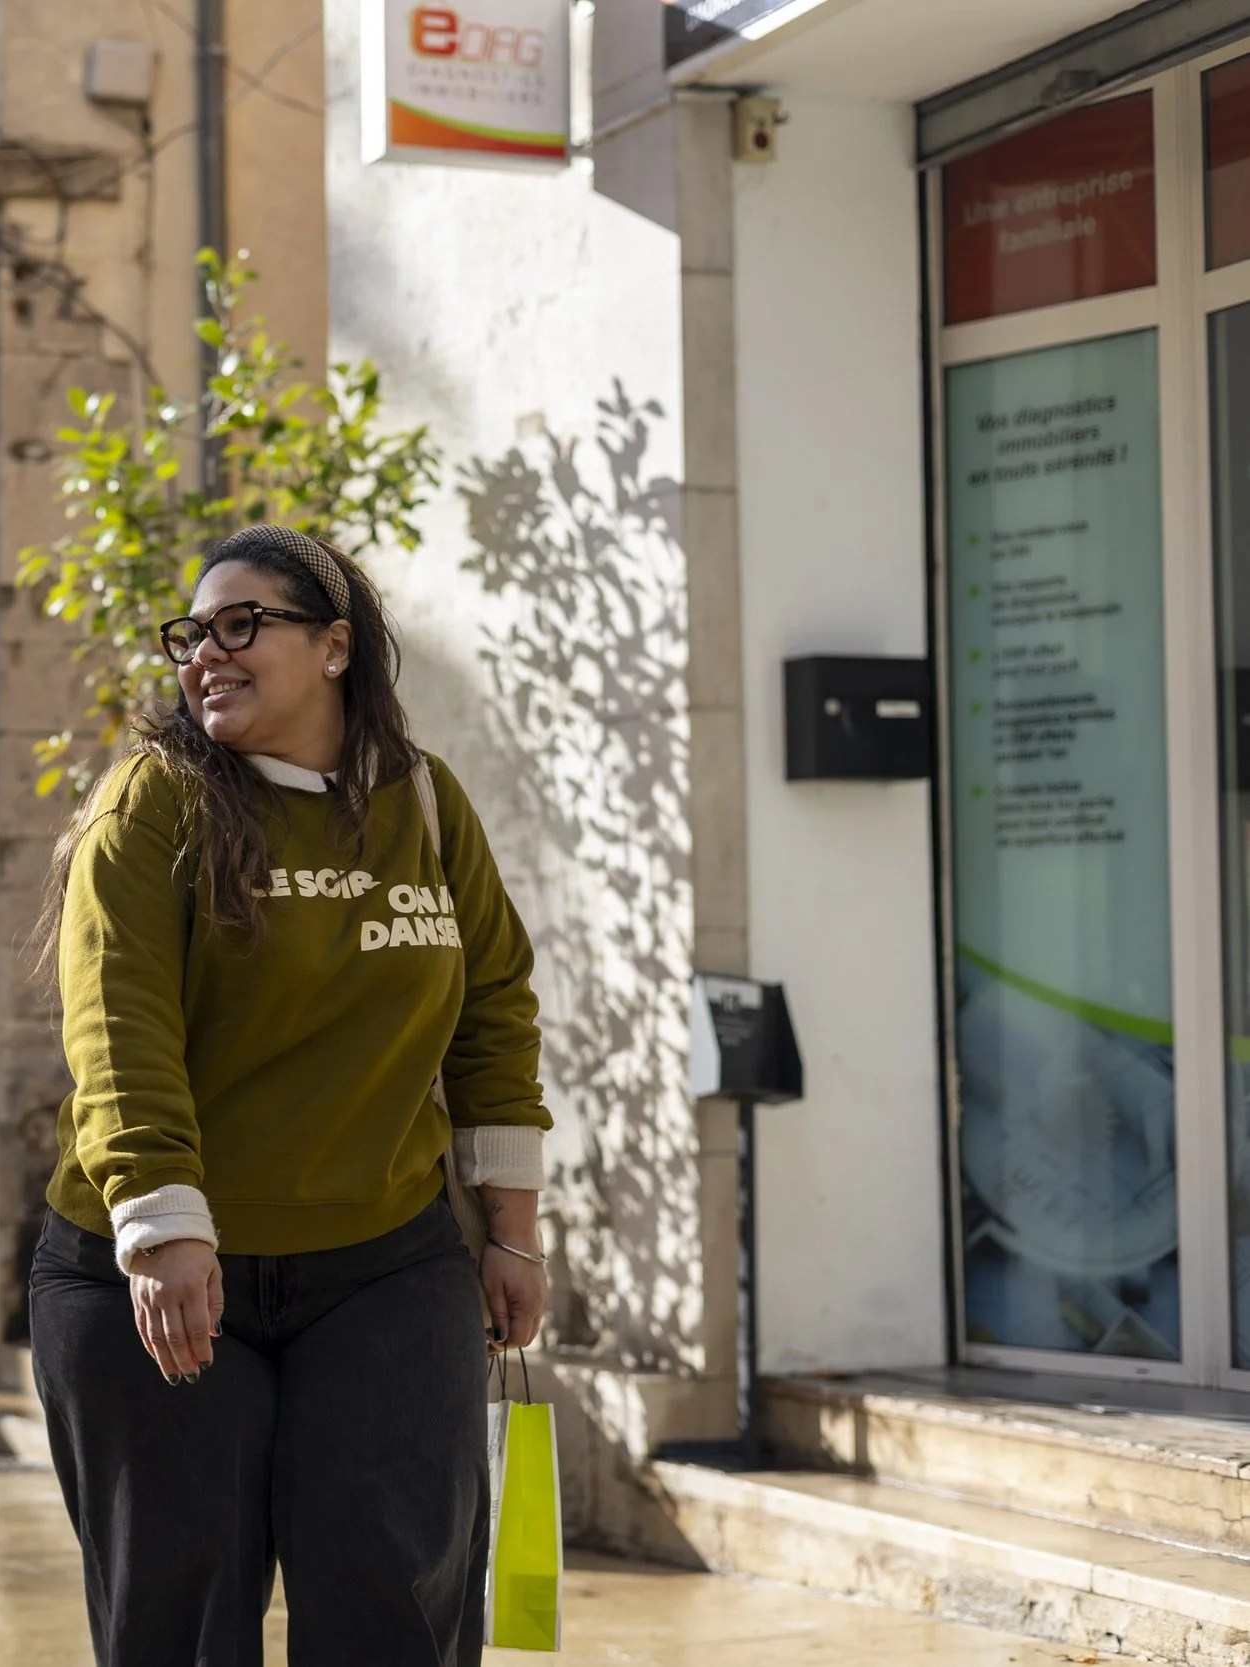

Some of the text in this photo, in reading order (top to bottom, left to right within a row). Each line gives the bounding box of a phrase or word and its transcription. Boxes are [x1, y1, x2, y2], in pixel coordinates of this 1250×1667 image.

[962, 170, 1134, 226] Une entreprise
[997, 213, 1098, 254] familiale
[1011, 394, 1118, 428] diagnostics
[996, 423, 1102, 456] immobiliers
[251, 868, 292, 898] E
[388, 884, 439, 914] ON
[361, 917, 463, 951] DANSE
